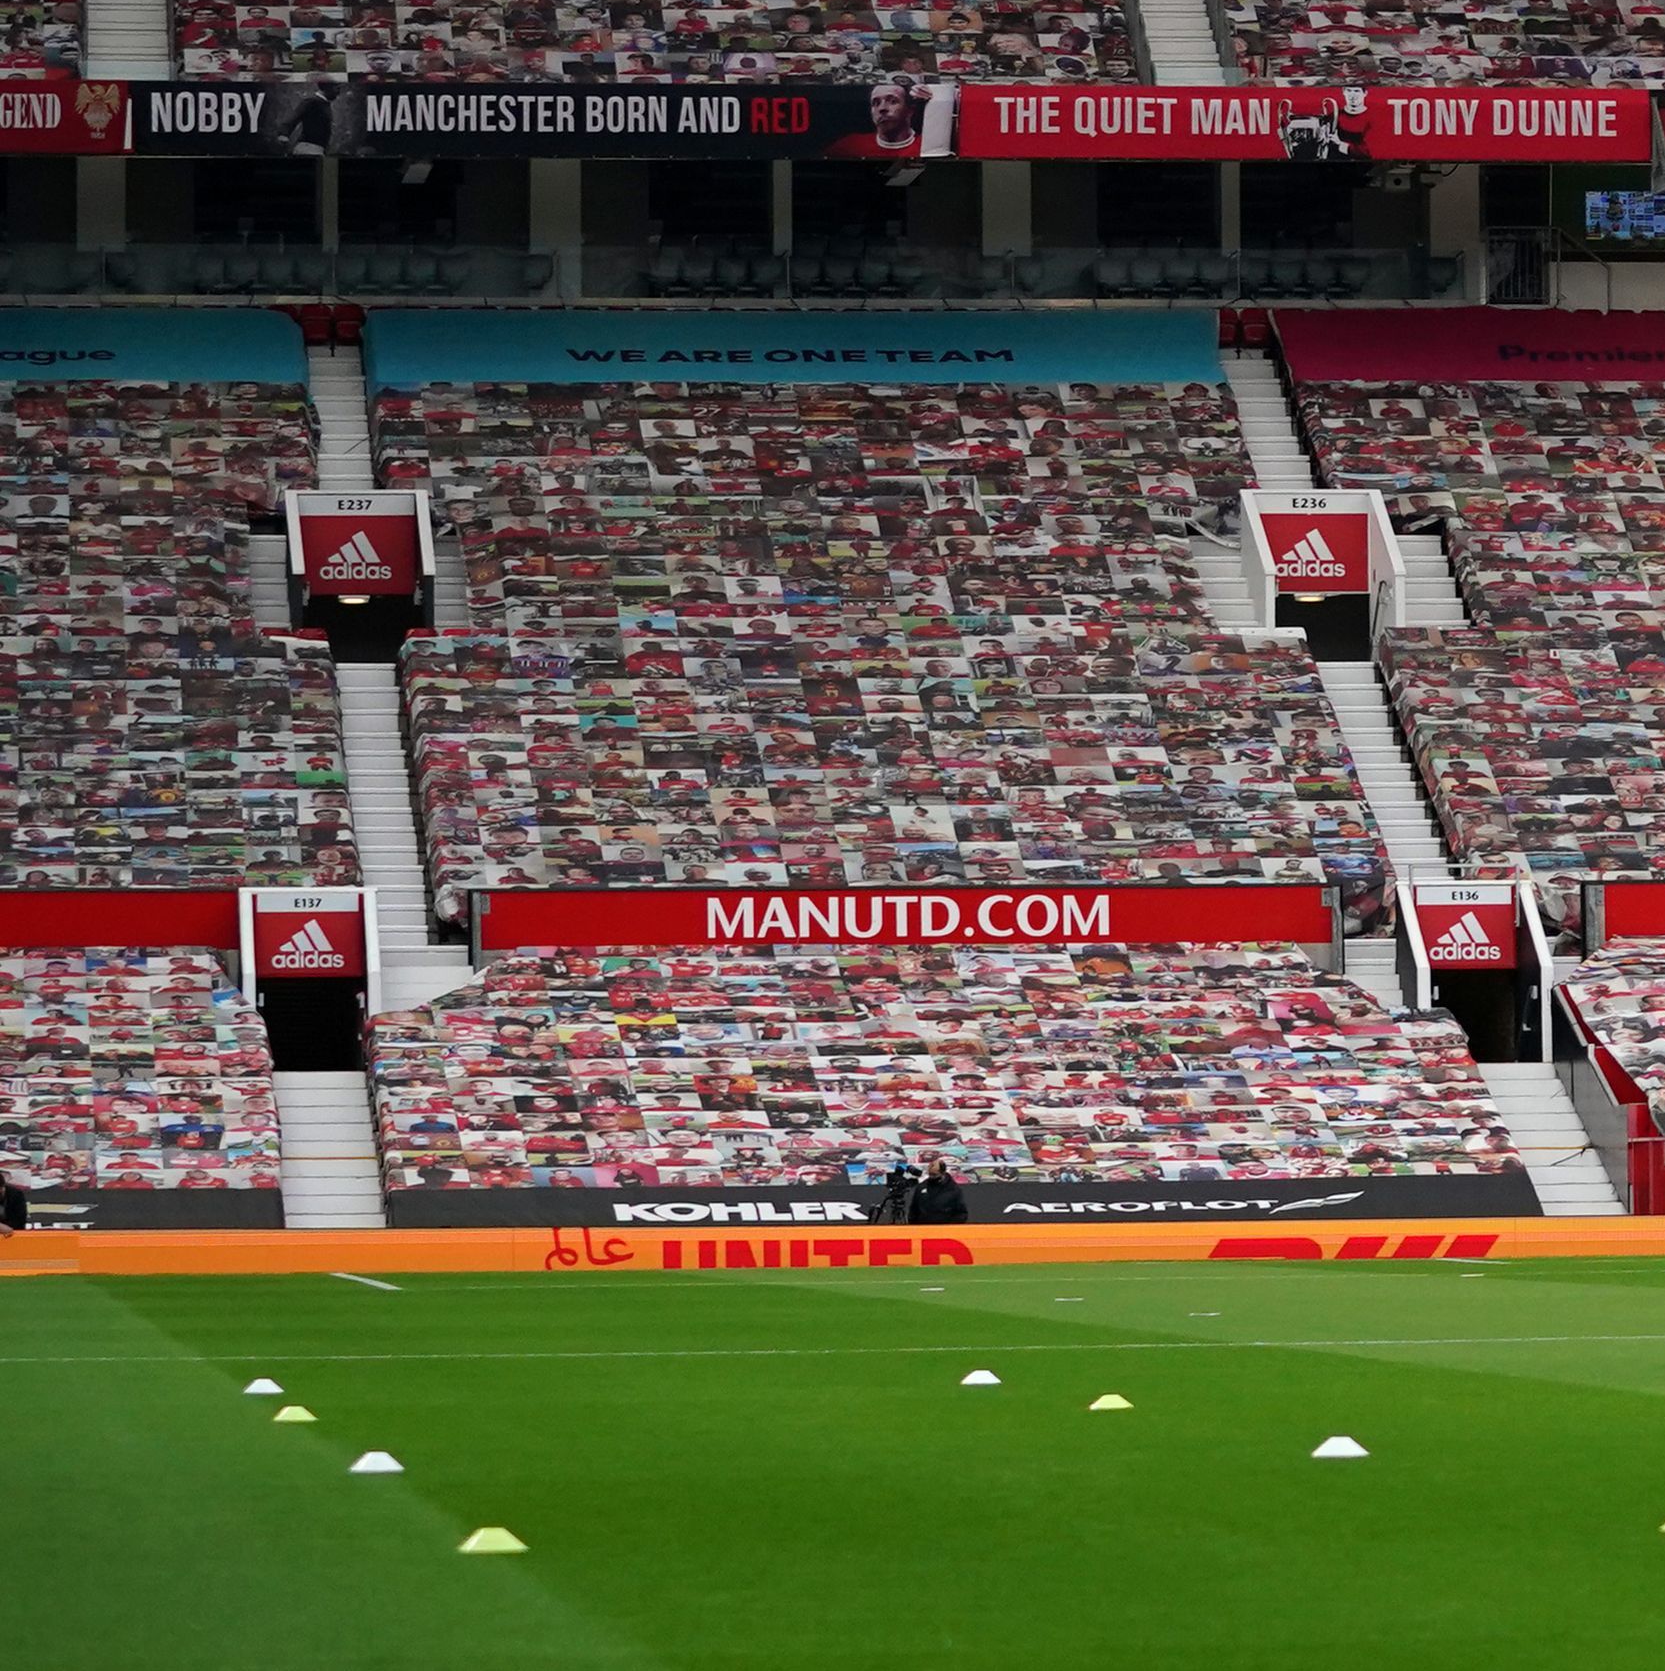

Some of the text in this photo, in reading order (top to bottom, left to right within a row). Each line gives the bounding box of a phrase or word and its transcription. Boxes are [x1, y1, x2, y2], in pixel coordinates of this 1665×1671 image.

[0, 93, 61, 128] GEND
[151, 91, 264, 134] NOBBY
[367, 92, 809, 134] MANCHESTER BORN AND RED
[995, 96, 1270, 137] THE QUIET MAN
[1389, 98, 1617, 137] TONY DUNNE
[566, 349, 1014, 363] WE ARE ONE TEAM
[338, 500, 372, 510] E237
[1293, 498, 1327, 508] E236
[320, 562, 392, 579] adidas
[1277, 560, 1346, 577] adidas
[294, 898, 321, 908] E137
[1452, 891, 1478, 900] E136
[706, 894, 1111, 939] MANUTD.COM
[272, 951, 345, 969] adidas
[1429, 943, 1502, 961] adidas
[612, 1202, 869, 1222] KOHLER
[1003, 1199, 1280, 1214] AEROFLOT
